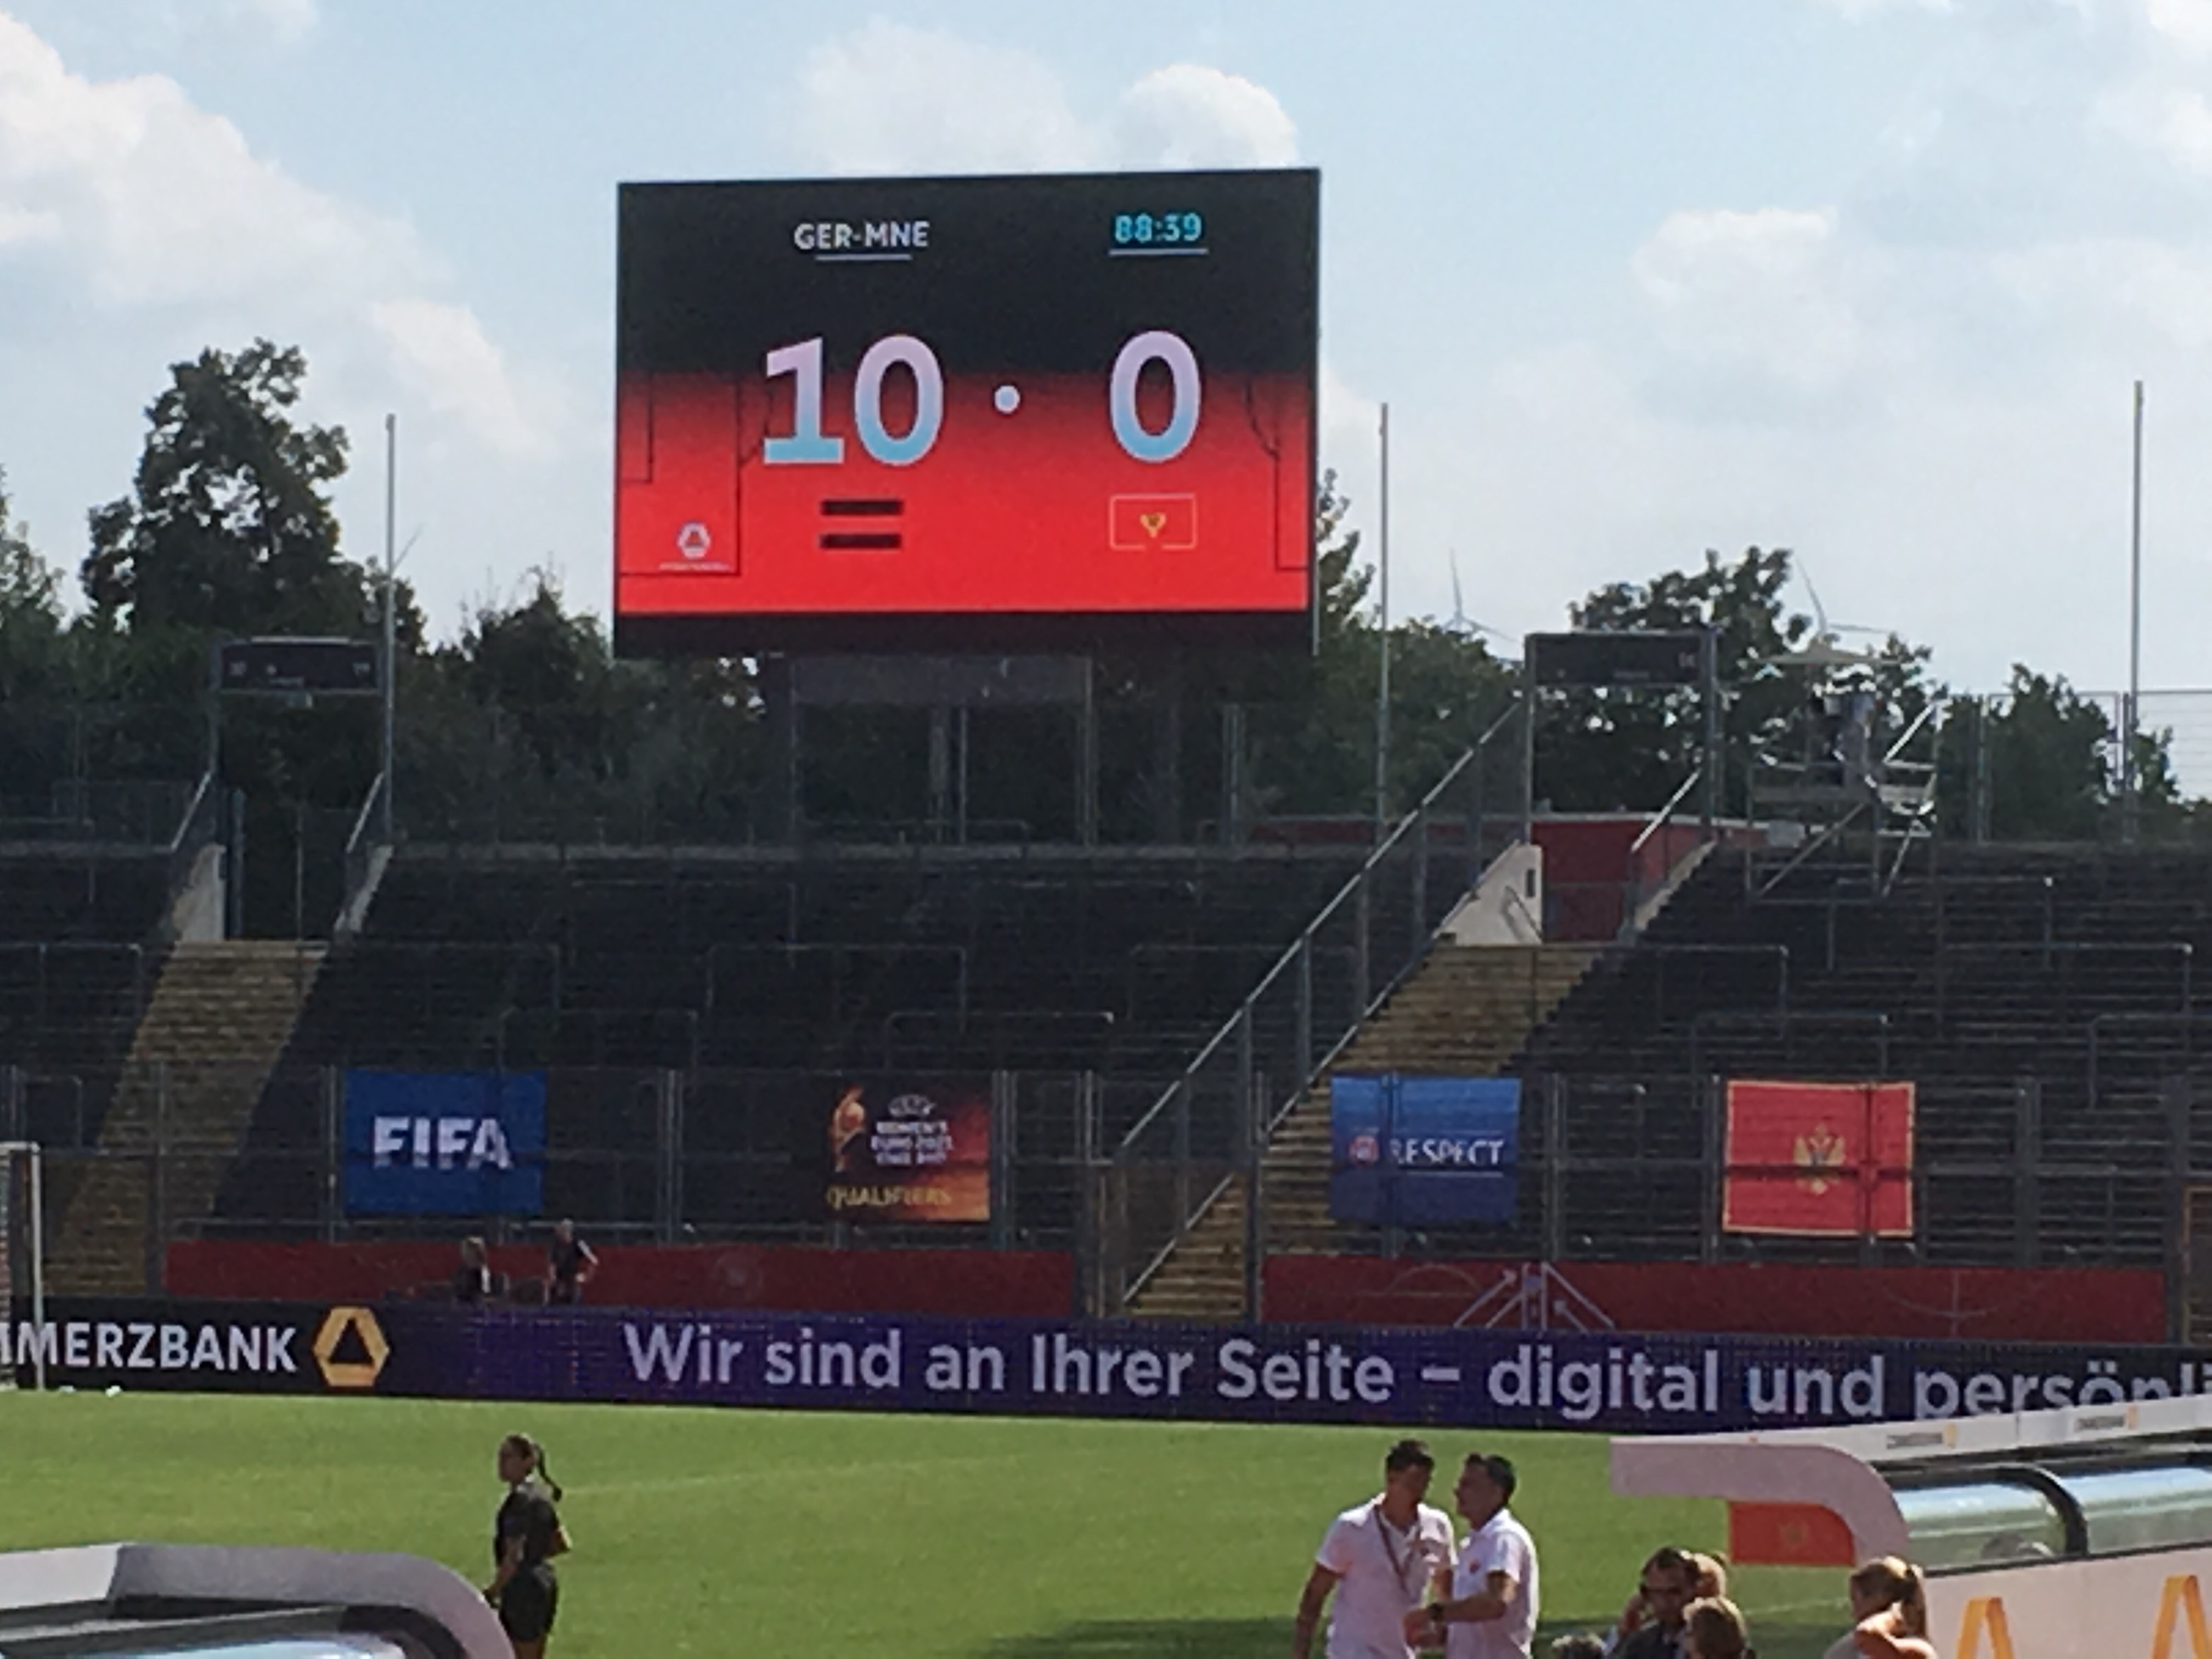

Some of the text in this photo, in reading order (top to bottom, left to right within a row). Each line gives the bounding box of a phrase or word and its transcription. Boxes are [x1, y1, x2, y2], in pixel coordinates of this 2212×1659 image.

[794, 221, 929, 249] GER-MNE
[763, 330, 1201, 466] 10 0
[374, 1116, 513, 1170] FIFA
[624, 1322, 743, 1384] Wir
[765, 1328, 900, 1388] sind
[926, 1344, 1004, 1390] an
[1032, 1333, 1194, 1396] Ihrer
[1217, 1339, 1394, 1403] Seite
[1487, 1344, 1718, 1420] digital
[1747, 1355, 1884, 1415] und
